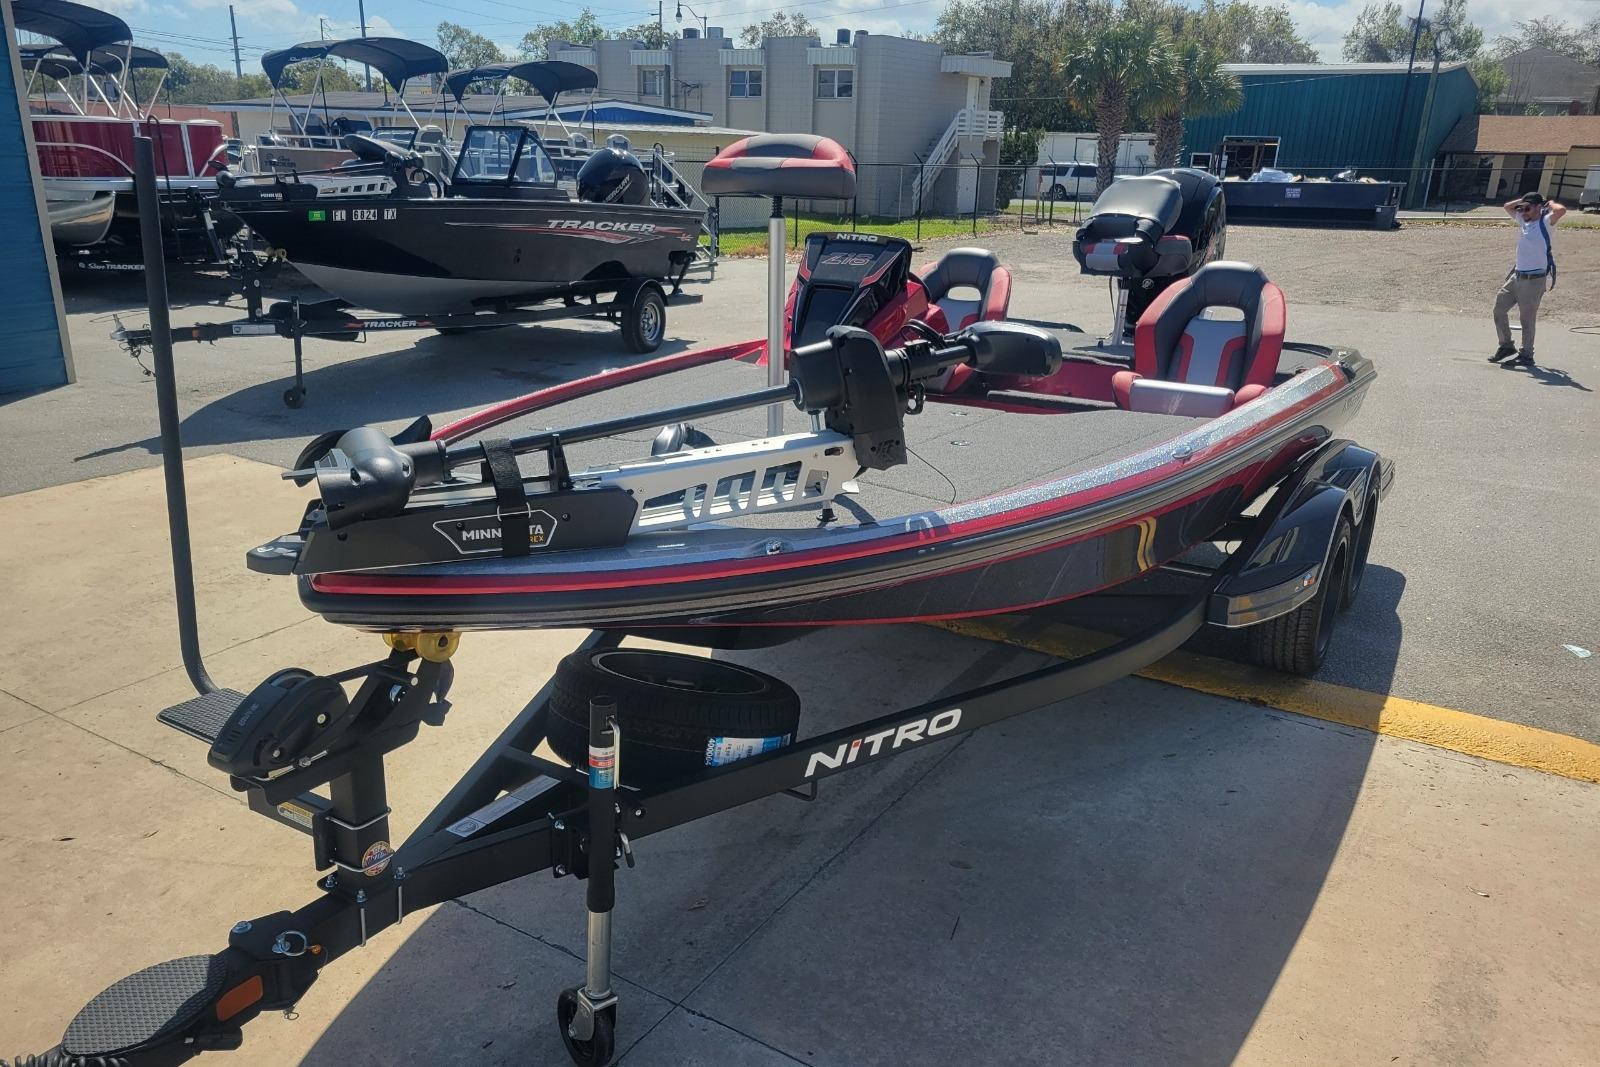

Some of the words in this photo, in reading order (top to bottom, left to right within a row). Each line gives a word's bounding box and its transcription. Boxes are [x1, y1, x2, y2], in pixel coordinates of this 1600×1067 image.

[333, 209, 347, 221] FL
[352, 209, 378, 221] 6824
[384, 208, 397, 220] TX
[547, 219, 656, 233] TRACKER
[363, 320, 417, 328] TRACKER
[462, 527, 502, 541] MINN
